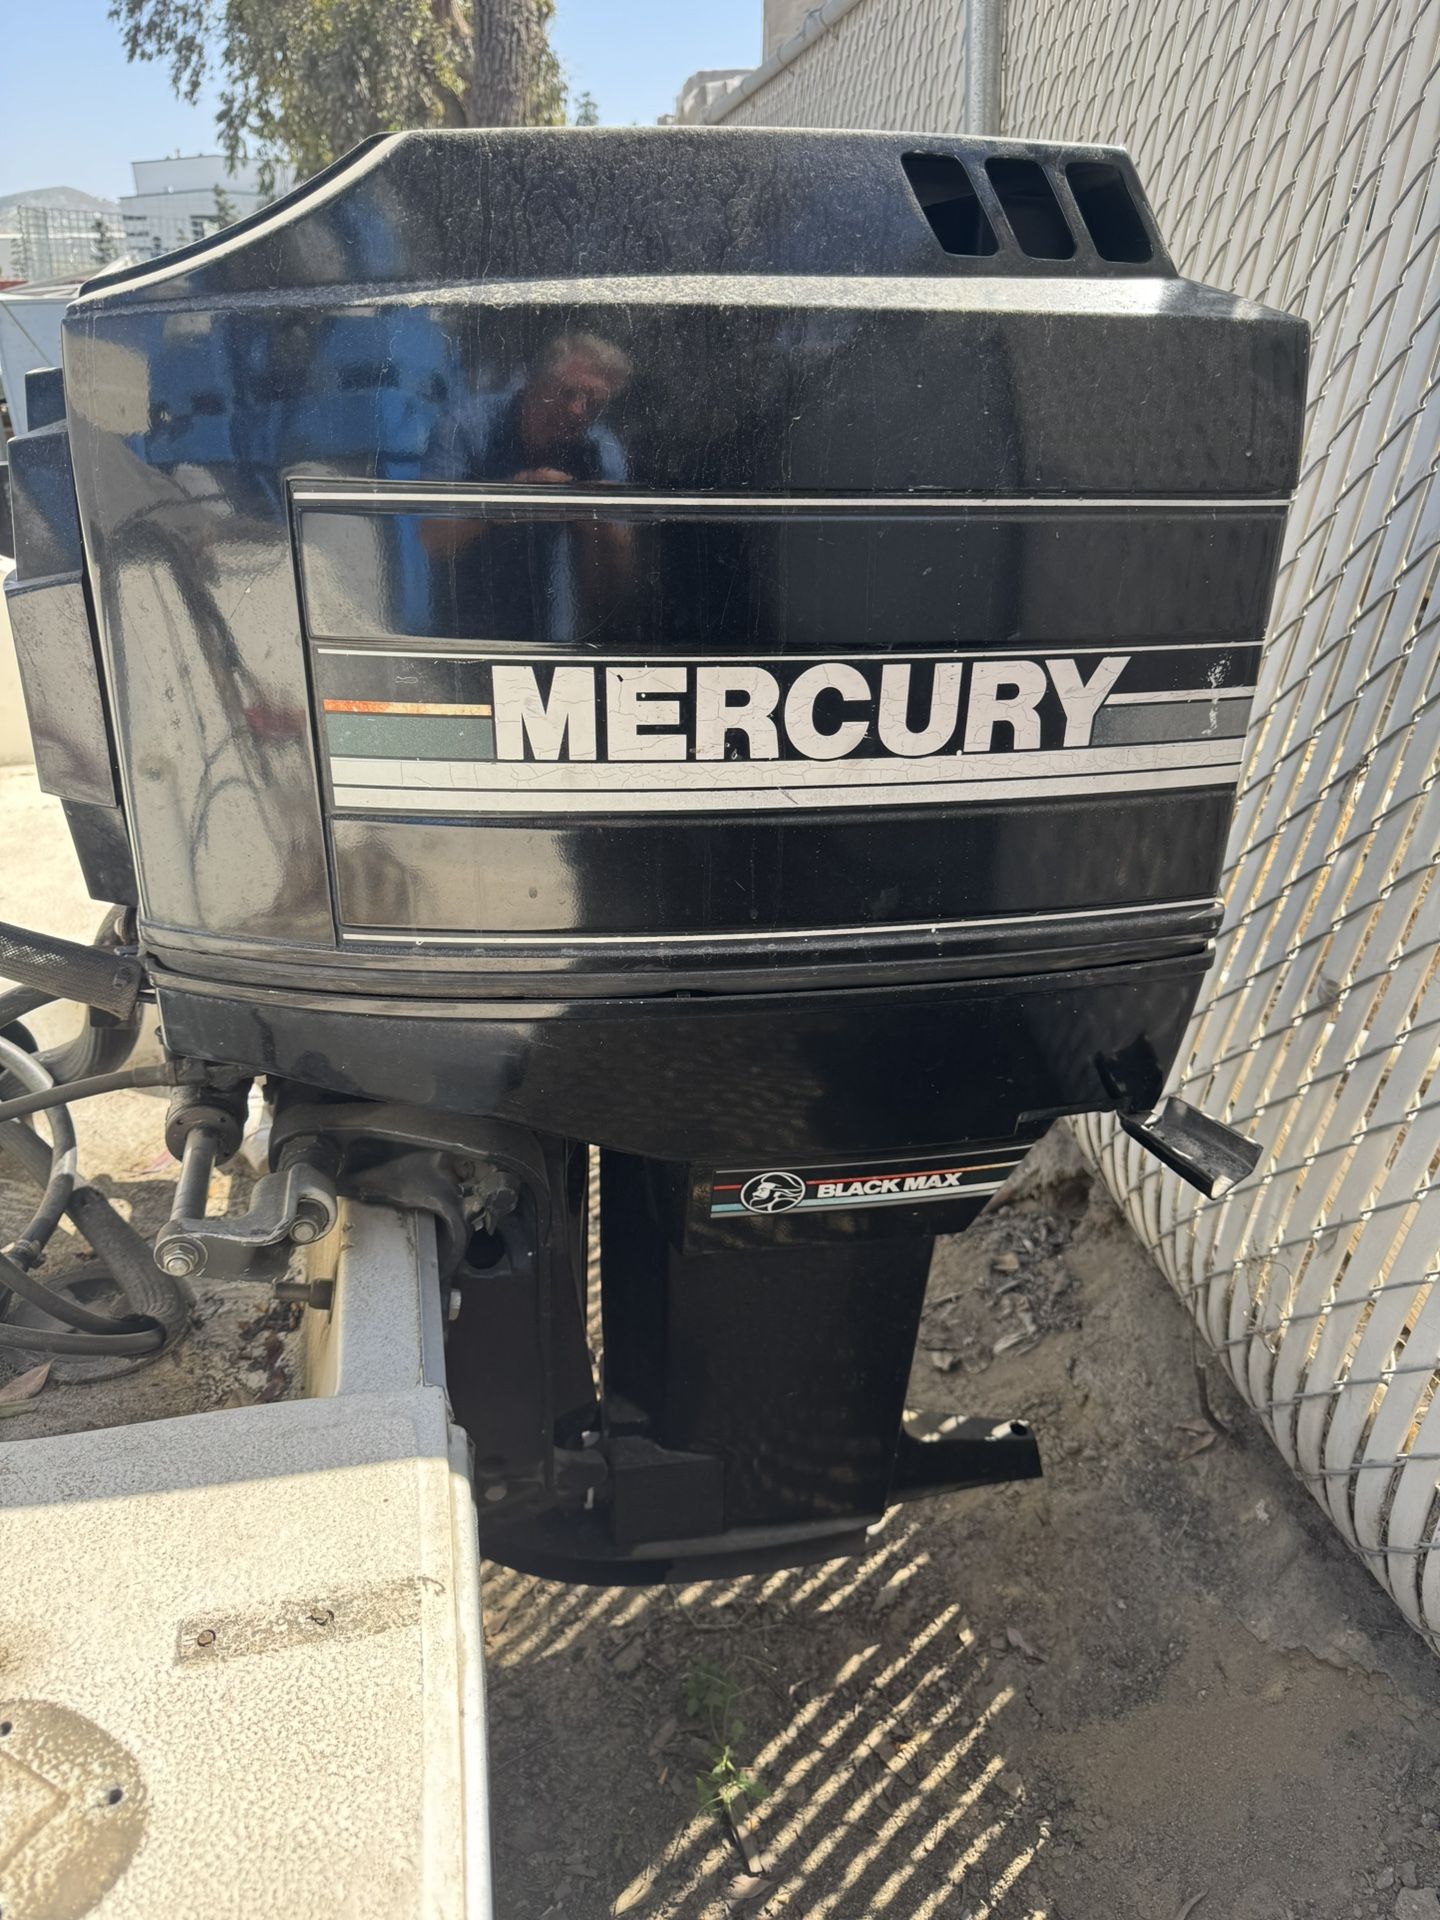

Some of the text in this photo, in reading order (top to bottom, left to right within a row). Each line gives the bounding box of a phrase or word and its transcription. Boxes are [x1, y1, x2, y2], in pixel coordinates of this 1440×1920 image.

[491, 656, 1132, 761] MERCURY
[817, 1173, 963, 1198] BLACK MAX
